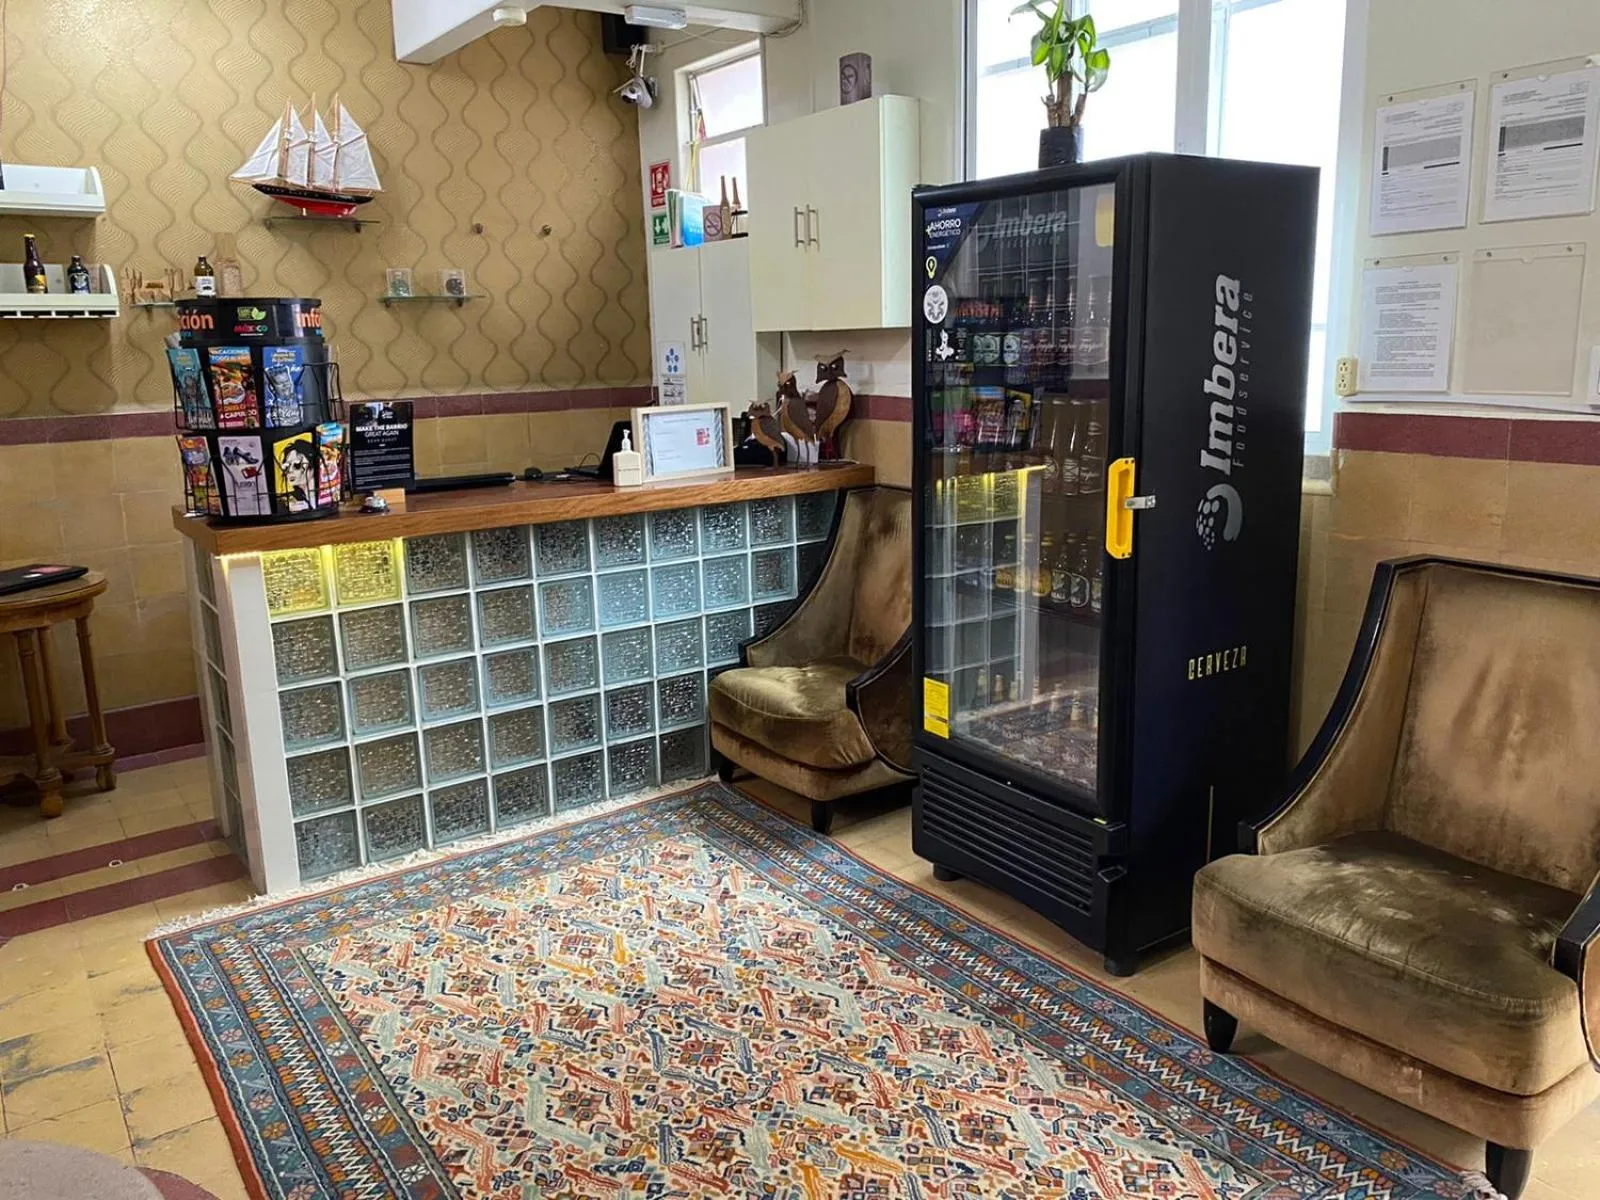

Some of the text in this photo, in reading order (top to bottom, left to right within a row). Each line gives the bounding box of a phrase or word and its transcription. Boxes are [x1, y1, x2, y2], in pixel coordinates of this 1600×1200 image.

[177, 308, 214, 330] ción
[1200, 274, 1241, 476] Imbera
[1232, 292, 1253, 468] Foodservice
[1188, 645, 1247, 680] CERVEZA
